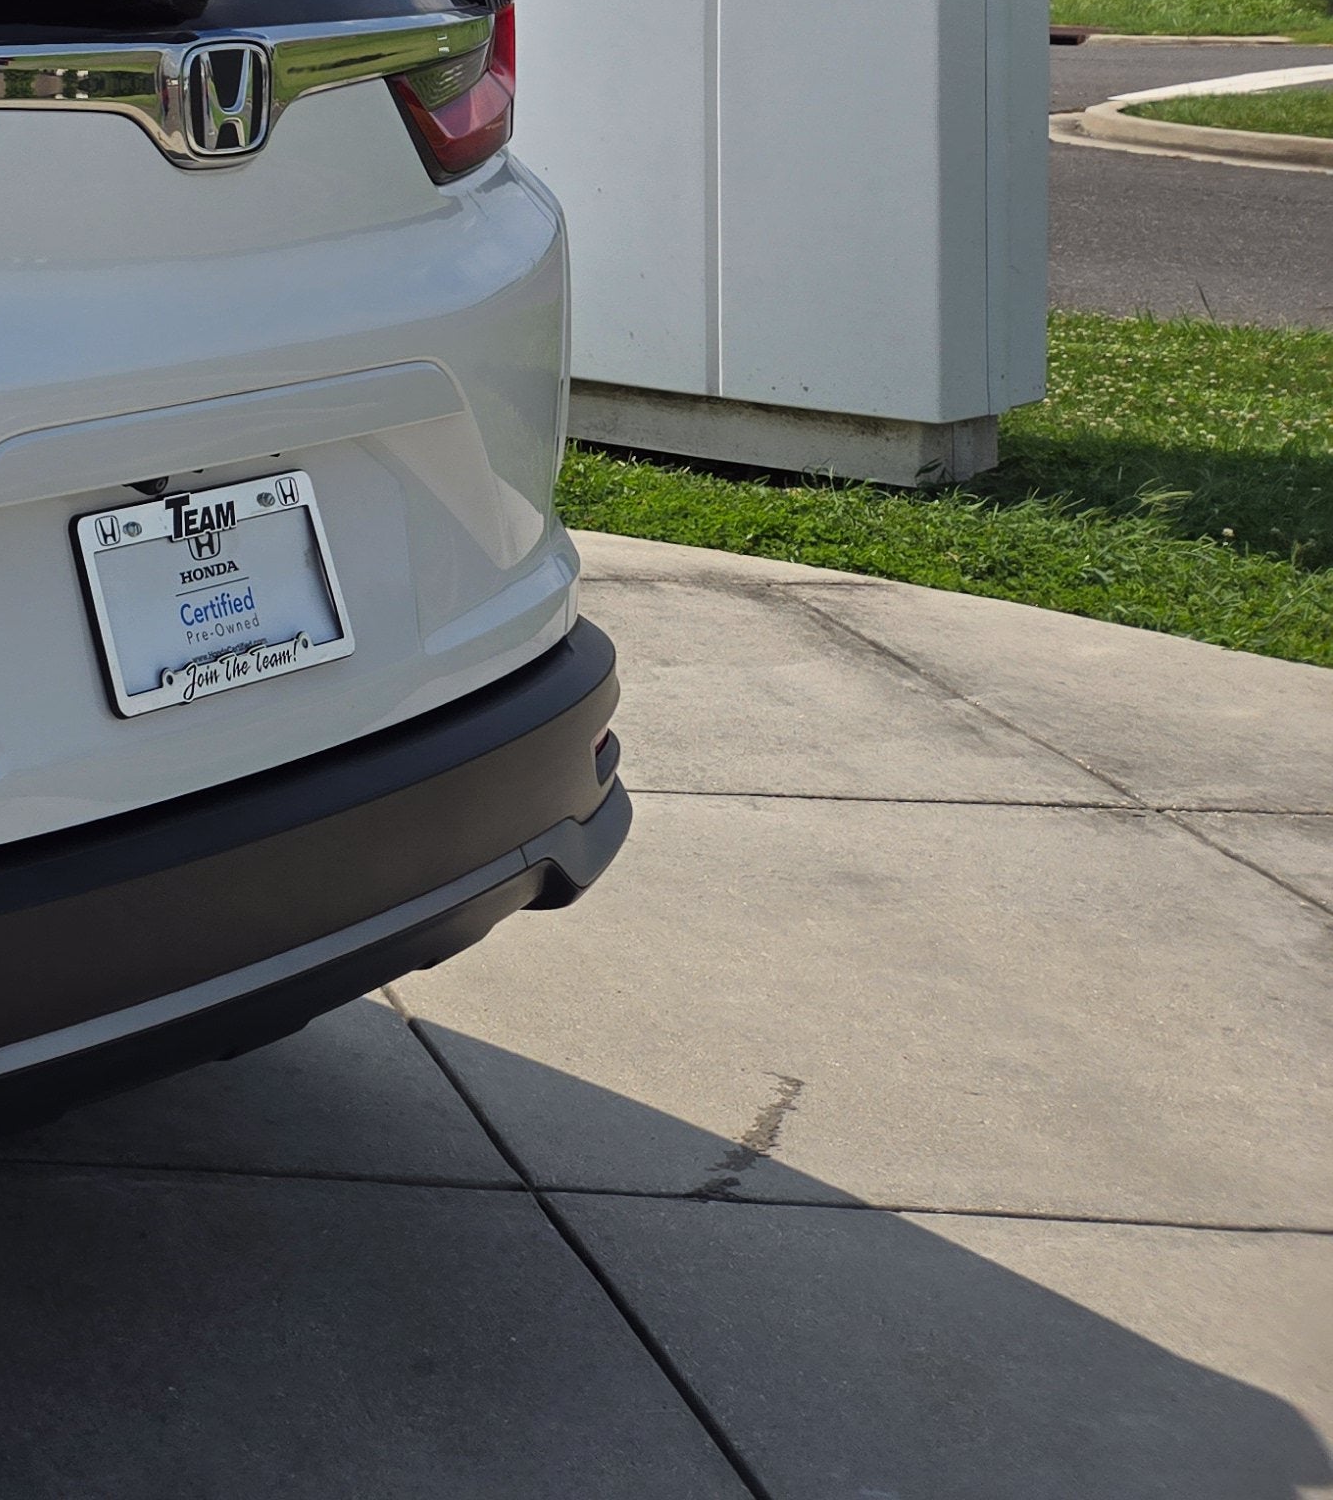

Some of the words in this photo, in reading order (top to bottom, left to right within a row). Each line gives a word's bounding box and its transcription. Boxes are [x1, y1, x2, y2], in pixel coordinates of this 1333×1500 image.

[179, 560, 240, 585] HONDA
[180, 586, 255, 626] Certified
[186, 613, 260, 645] Pre-Owned
[183, 664, 220, 701] Join
[219, 654, 250, 682] The
